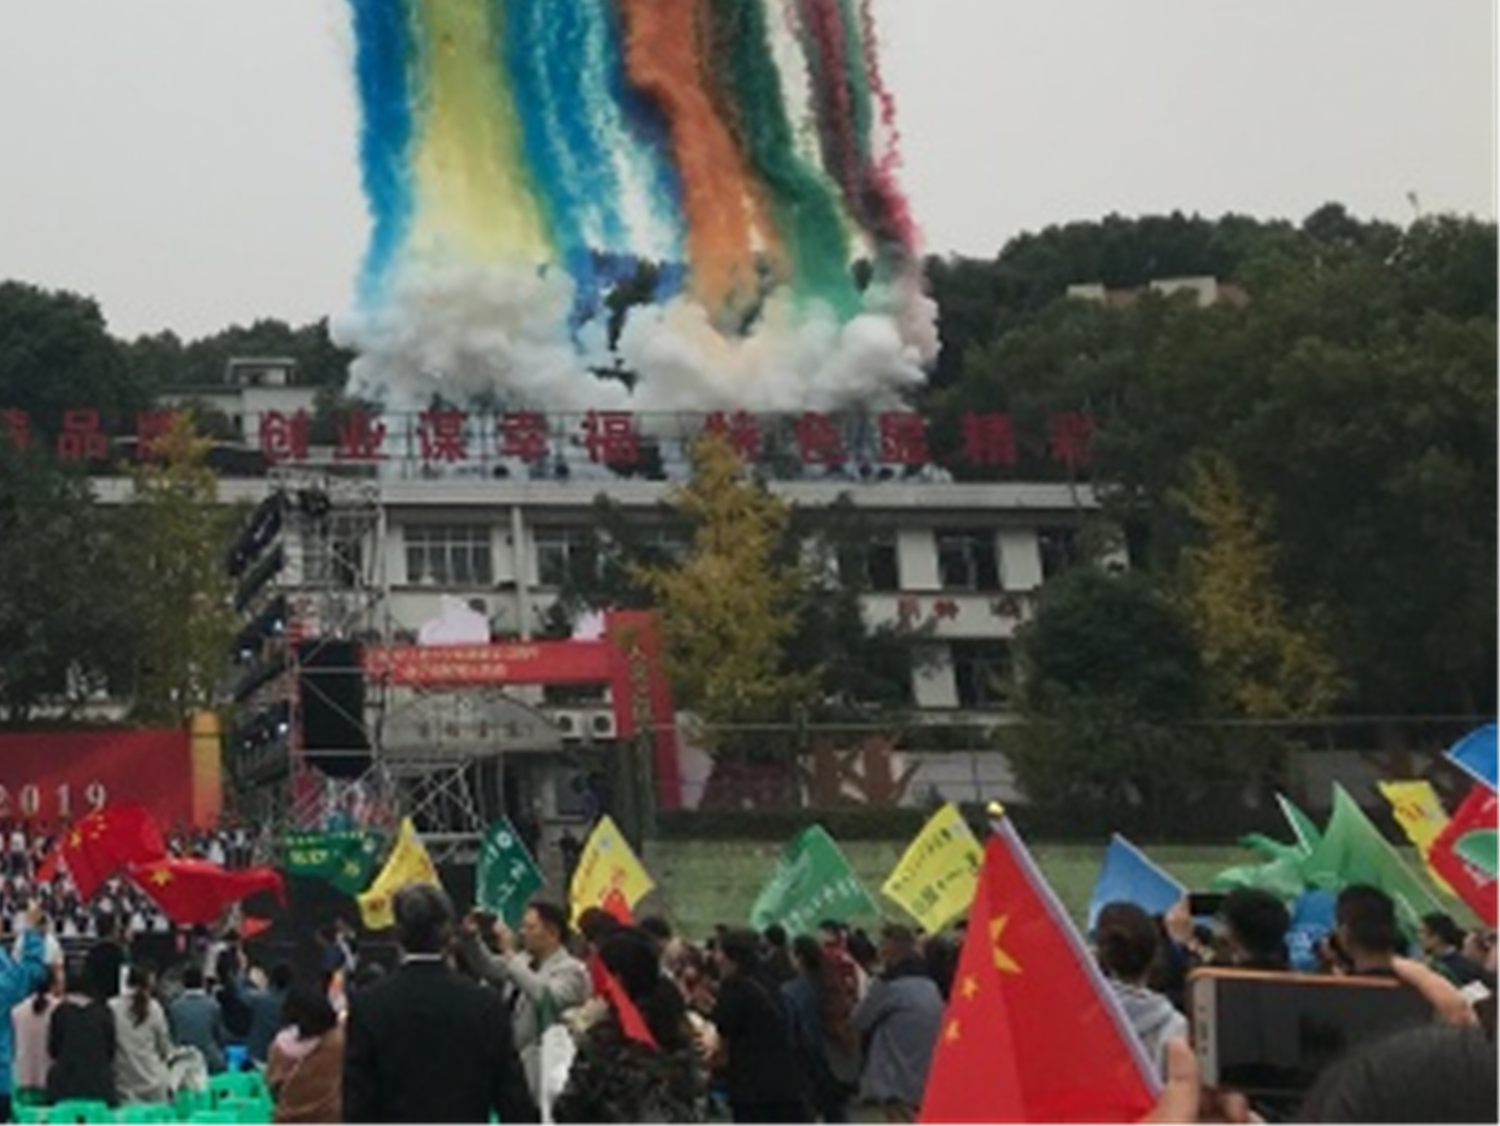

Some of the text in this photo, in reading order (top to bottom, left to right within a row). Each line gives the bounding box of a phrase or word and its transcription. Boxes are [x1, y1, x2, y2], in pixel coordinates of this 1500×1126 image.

[259, 409, 642, 464] 创业谋幸福
